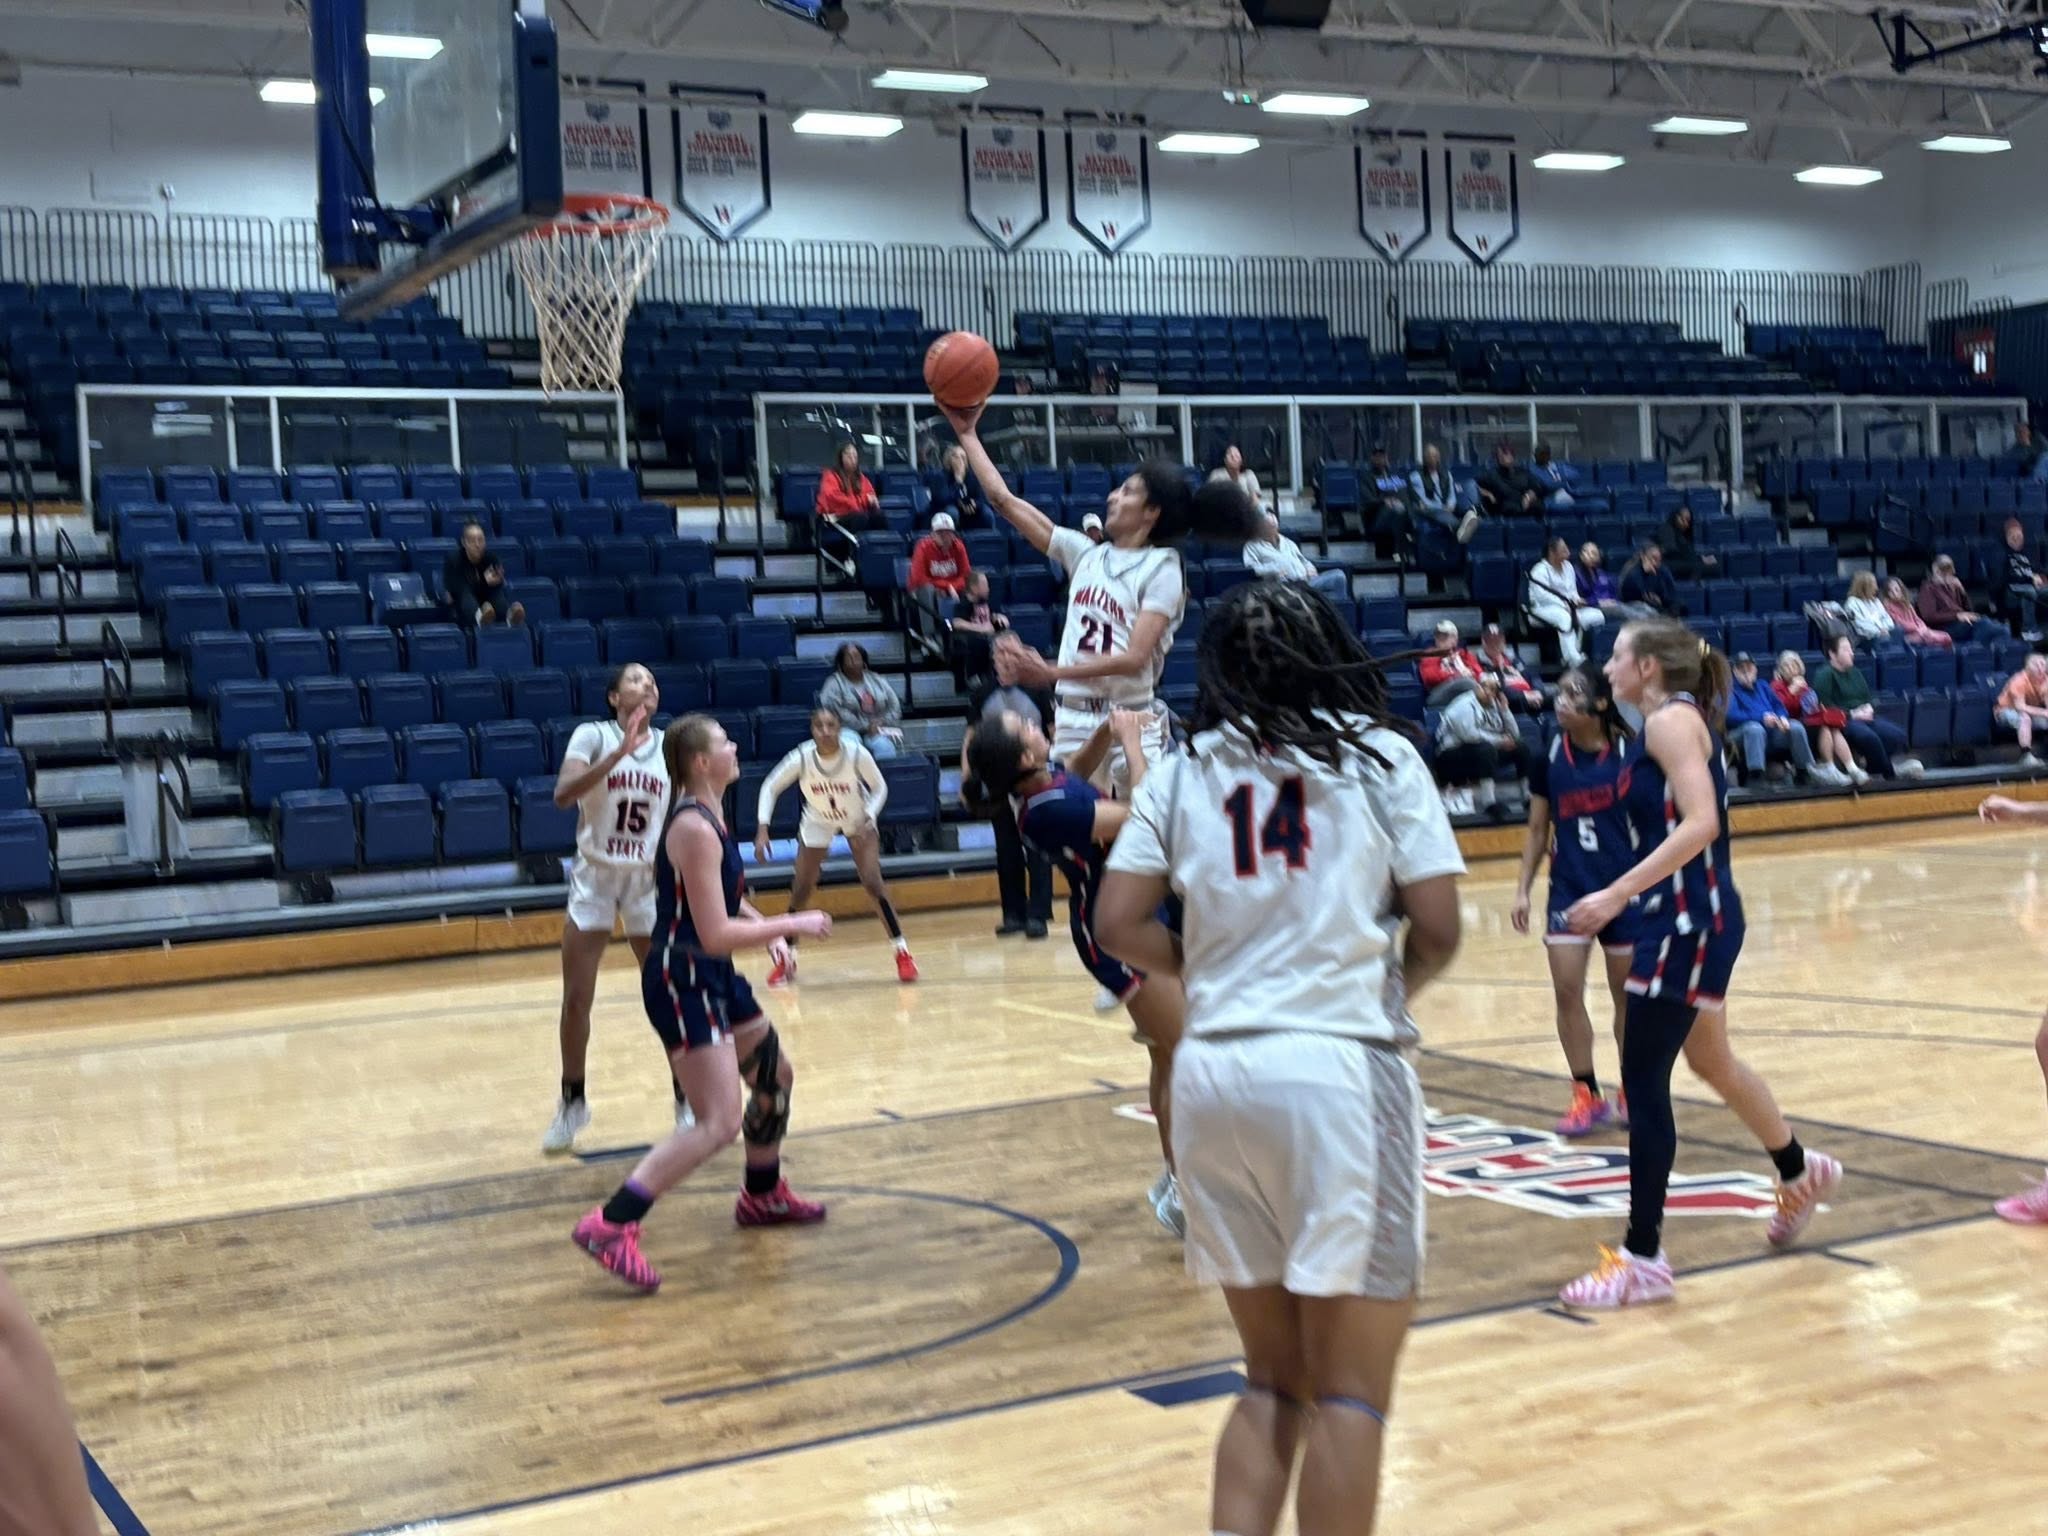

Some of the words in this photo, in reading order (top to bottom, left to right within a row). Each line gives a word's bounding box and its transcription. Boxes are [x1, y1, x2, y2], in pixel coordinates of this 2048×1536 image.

[1077, 615, 1113, 656] 21
[616, 798, 650, 834] 15
[1223, 773, 1313, 879] 14
[1577, 816, 1600, 852] 5
